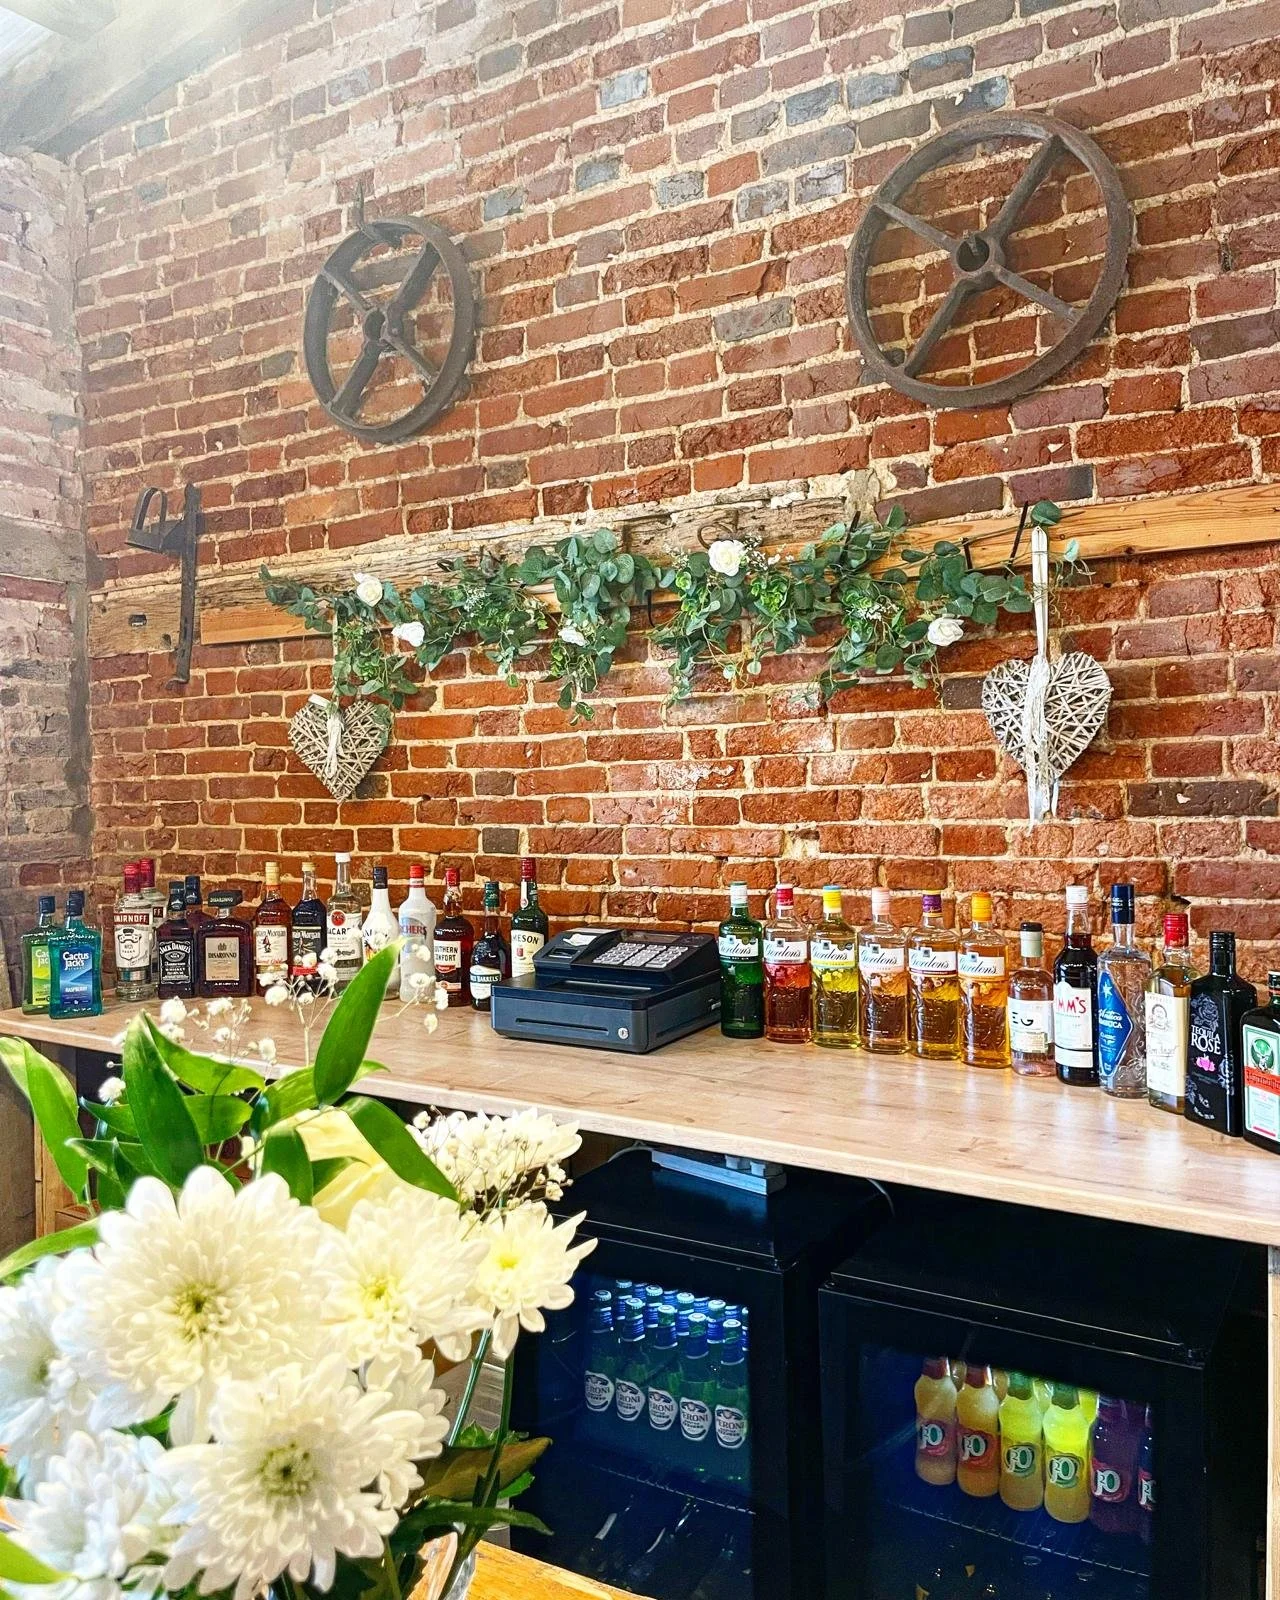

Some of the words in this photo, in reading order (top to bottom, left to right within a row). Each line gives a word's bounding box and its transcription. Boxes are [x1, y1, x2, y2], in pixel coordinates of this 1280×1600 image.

[62, 951, 90, 961] Cactus
[159, 944, 171, 955] JACK
[765, 944, 802, 958] Gordon's
[812, 945, 848, 961] Gordon's
[861, 949, 898, 965] Gordon's
[911, 952, 950, 969] Gordon's
[960, 957, 997, 974] Gordon's
[1191, 1024, 1220, 1041] TEQUILA
[1191, 1033, 1222, 1055] ROSE
